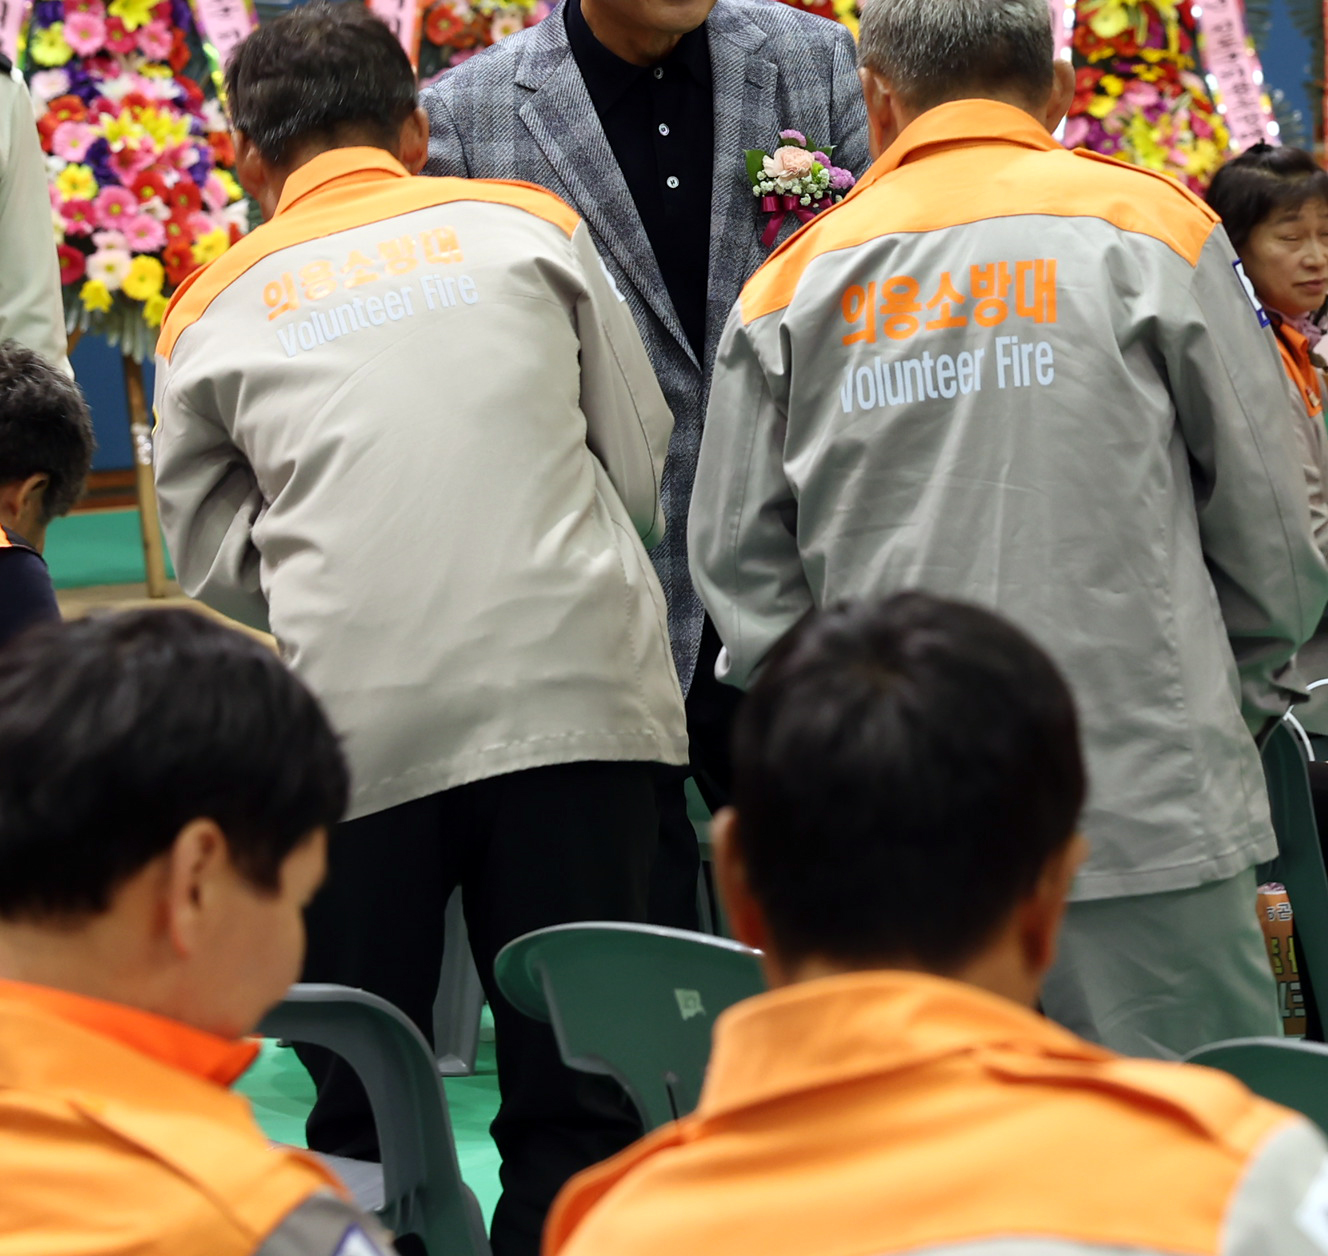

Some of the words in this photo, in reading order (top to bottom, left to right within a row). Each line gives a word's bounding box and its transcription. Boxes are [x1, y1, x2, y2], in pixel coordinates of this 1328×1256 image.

[263, 225, 464, 321] 의용소방대
[276, 284, 414, 358] Volunteer
[419, 272, 479, 311] Fire
[841, 257, 1058, 346] 의용소방대
[840, 346, 985, 413] Volunteer
[995, 335, 1055, 389] Fire
